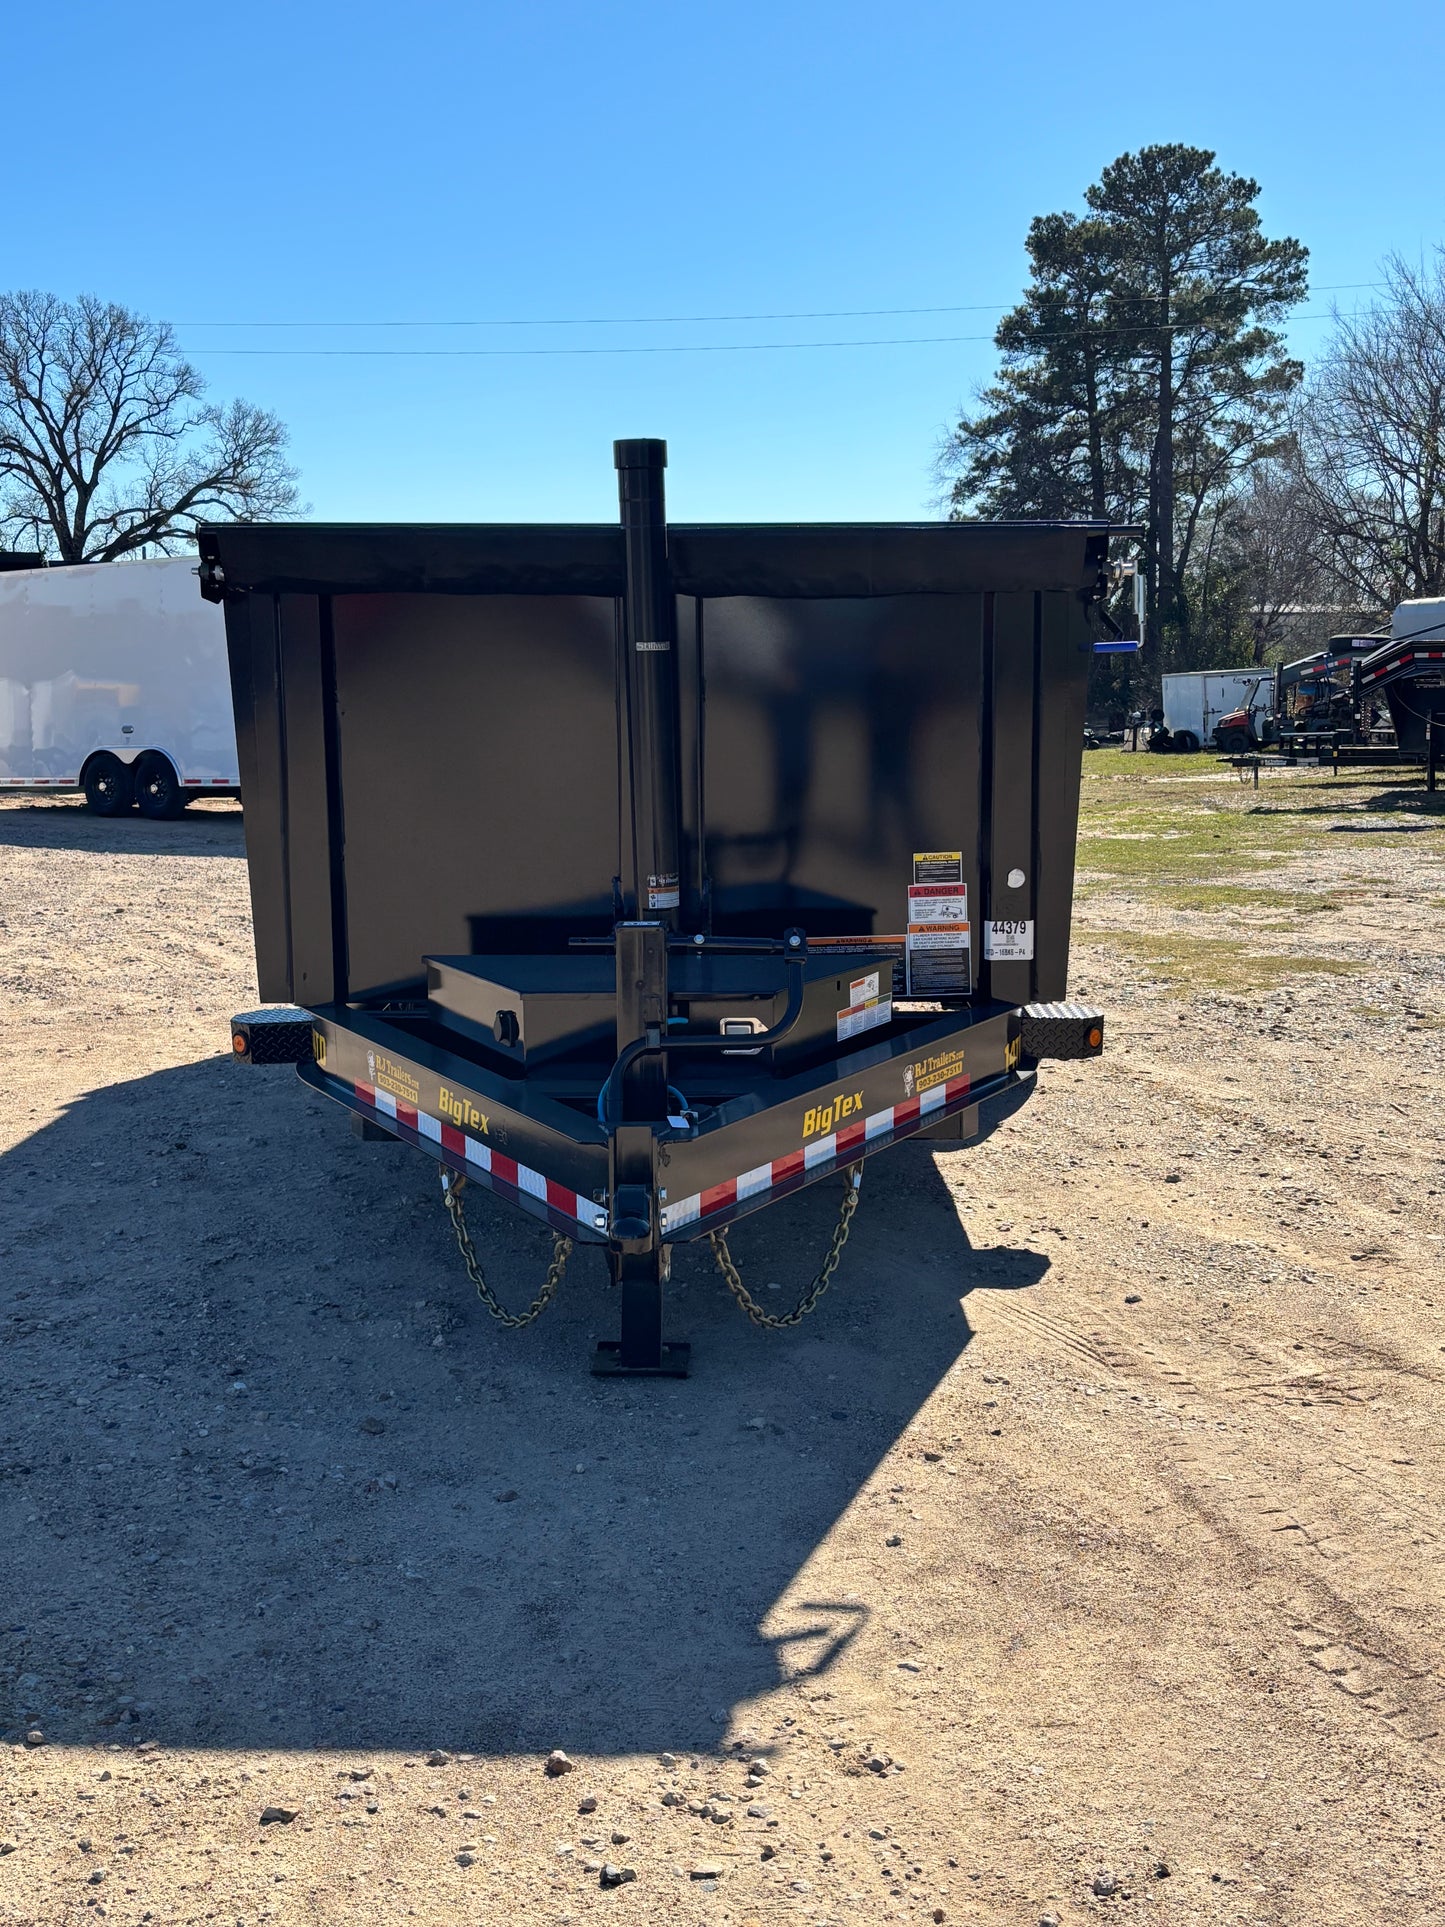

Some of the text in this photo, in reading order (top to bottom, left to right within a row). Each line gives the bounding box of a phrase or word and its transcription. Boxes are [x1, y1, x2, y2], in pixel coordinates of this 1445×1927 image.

[924, 887, 959, 895] DANGER
[992, 921, 1026, 935] 44379
[376, 1055, 386, 1072] RJ
[915, 1060, 928, 1078] RJ
[918, 1064, 961, 1089] 903-230-7511
[379, 1073, 418, 1101] 903-230-7511
